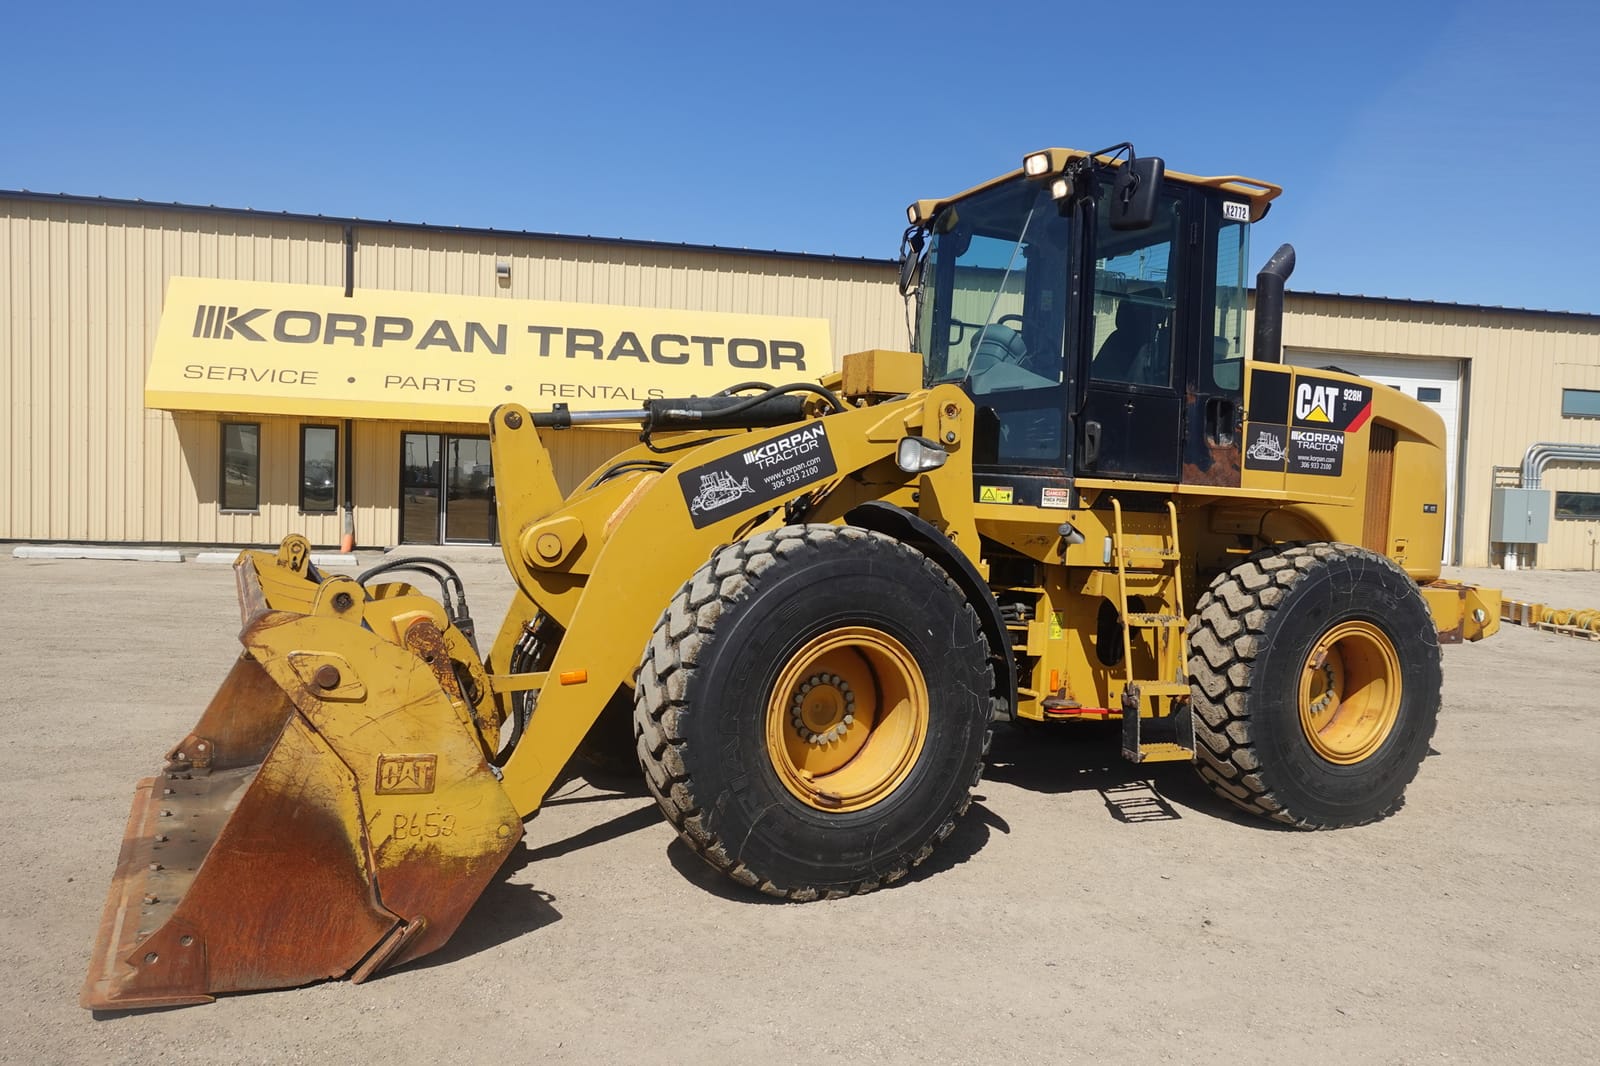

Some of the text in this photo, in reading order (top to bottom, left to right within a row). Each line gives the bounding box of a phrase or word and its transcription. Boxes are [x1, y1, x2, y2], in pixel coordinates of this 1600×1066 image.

[192, 304, 807, 371] KORPAN TRACTOR
[183, 364, 665, 402] SERVICE PARTS RENTALS
[1343, 388, 1363, 402] 928H
[1295, 383, 1340, 423] CAT
[744, 425, 824, 464] KORPAN
[1291, 430, 1344, 445] KORPAN
[1297, 440, 1338, 452] TRACTOR
[754, 439, 819, 470] TRACTOR
[1297, 454, 1336, 464] www.korpan.com
[763, 457, 821, 484] www.korpan.com
[771, 465, 819, 490] 306 933 2100
[381, 759, 432, 790] CAT
